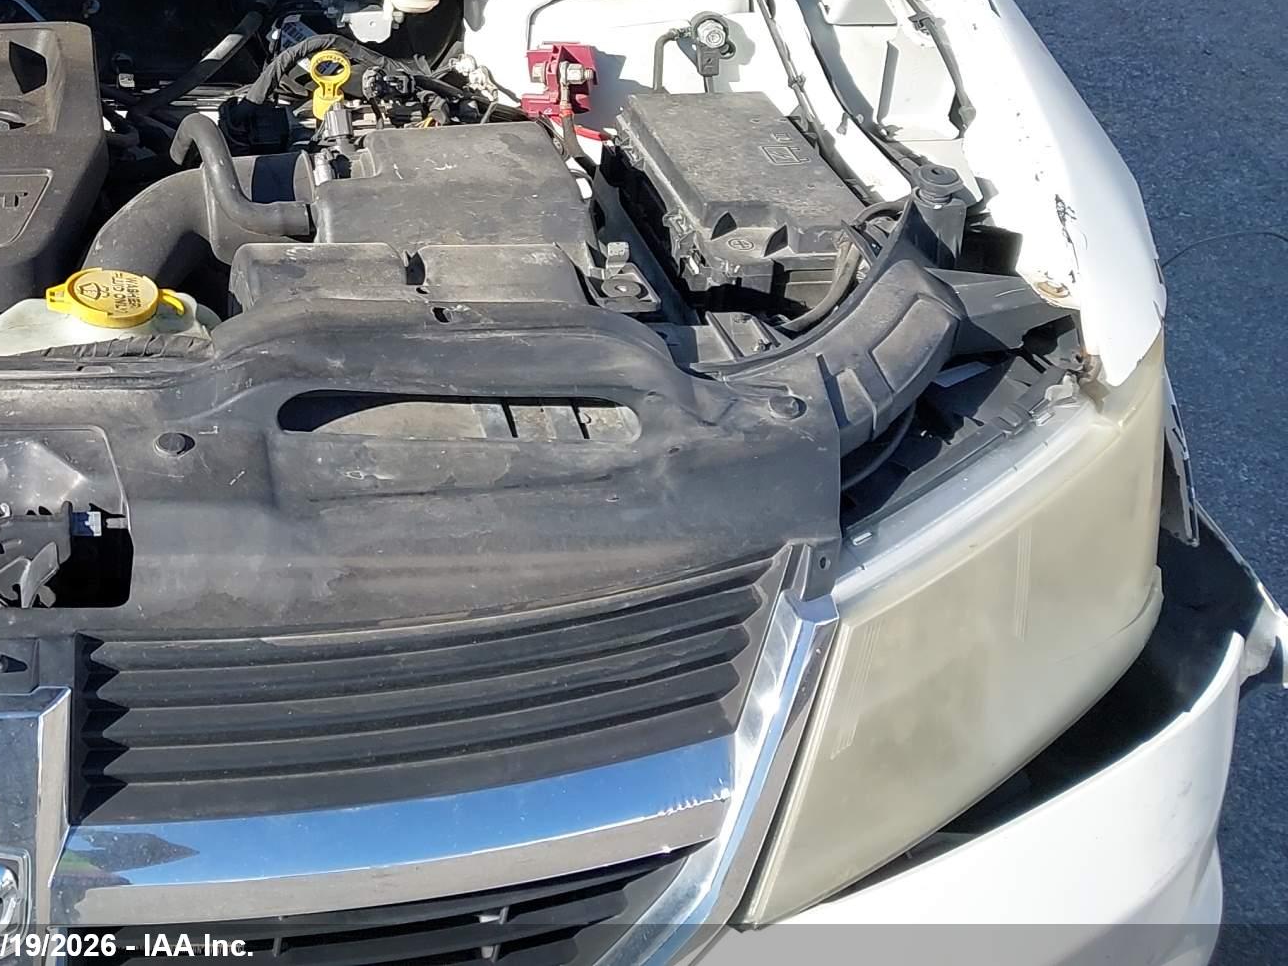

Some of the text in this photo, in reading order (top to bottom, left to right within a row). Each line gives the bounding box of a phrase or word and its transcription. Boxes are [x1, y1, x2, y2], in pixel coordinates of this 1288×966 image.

[112, 272, 129, 314] FLUID ONLY
[125, 277, 142, 309] WASHER
